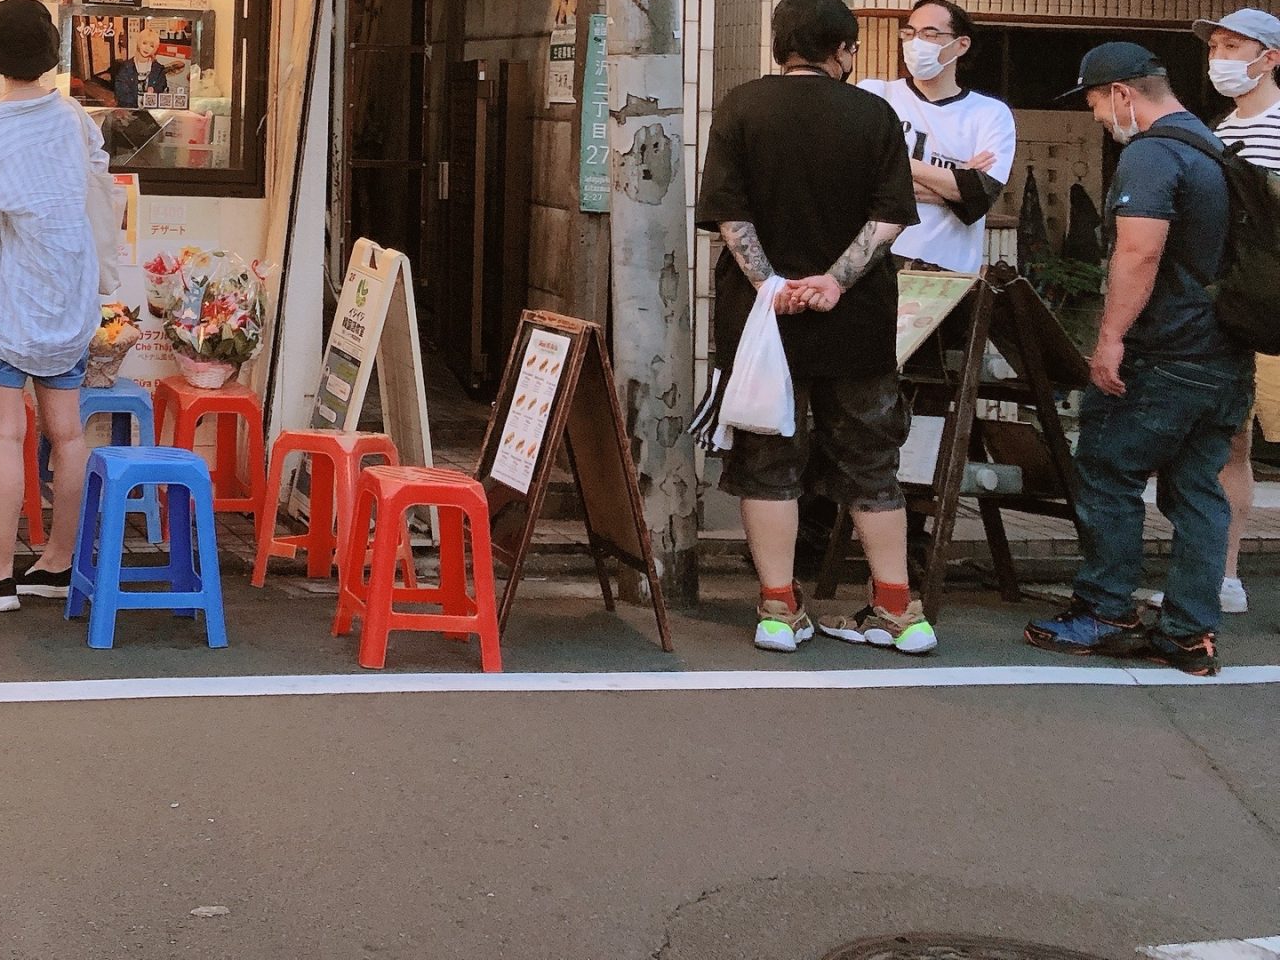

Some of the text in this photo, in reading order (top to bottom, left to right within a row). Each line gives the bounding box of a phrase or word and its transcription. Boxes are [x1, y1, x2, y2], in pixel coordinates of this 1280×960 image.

[586, 145, 610, 165] 27
[151, 224, 186, 236] デザート
